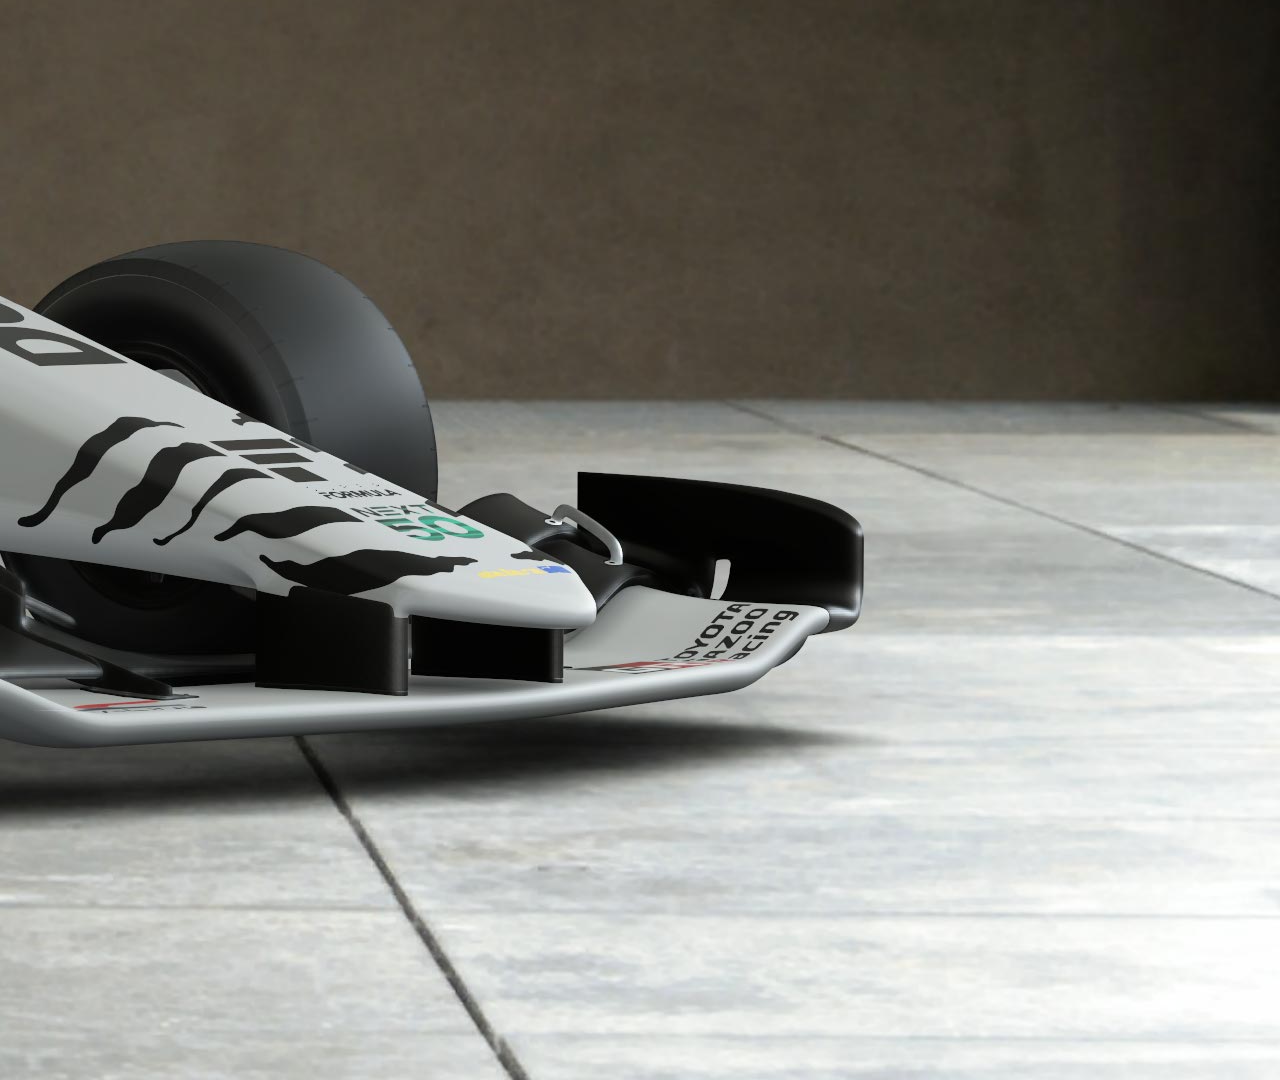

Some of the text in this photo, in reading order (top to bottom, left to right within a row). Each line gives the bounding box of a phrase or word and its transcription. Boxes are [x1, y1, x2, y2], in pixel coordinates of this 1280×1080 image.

[317, 488, 403, 500] FORMULA
[349, 504, 436, 518] NEXT
[374, 515, 486, 542] 50
[662, 603, 752, 660] OYOTA
[693, 608, 769, 661] AZOO
[712, 610, 800, 662] acing
